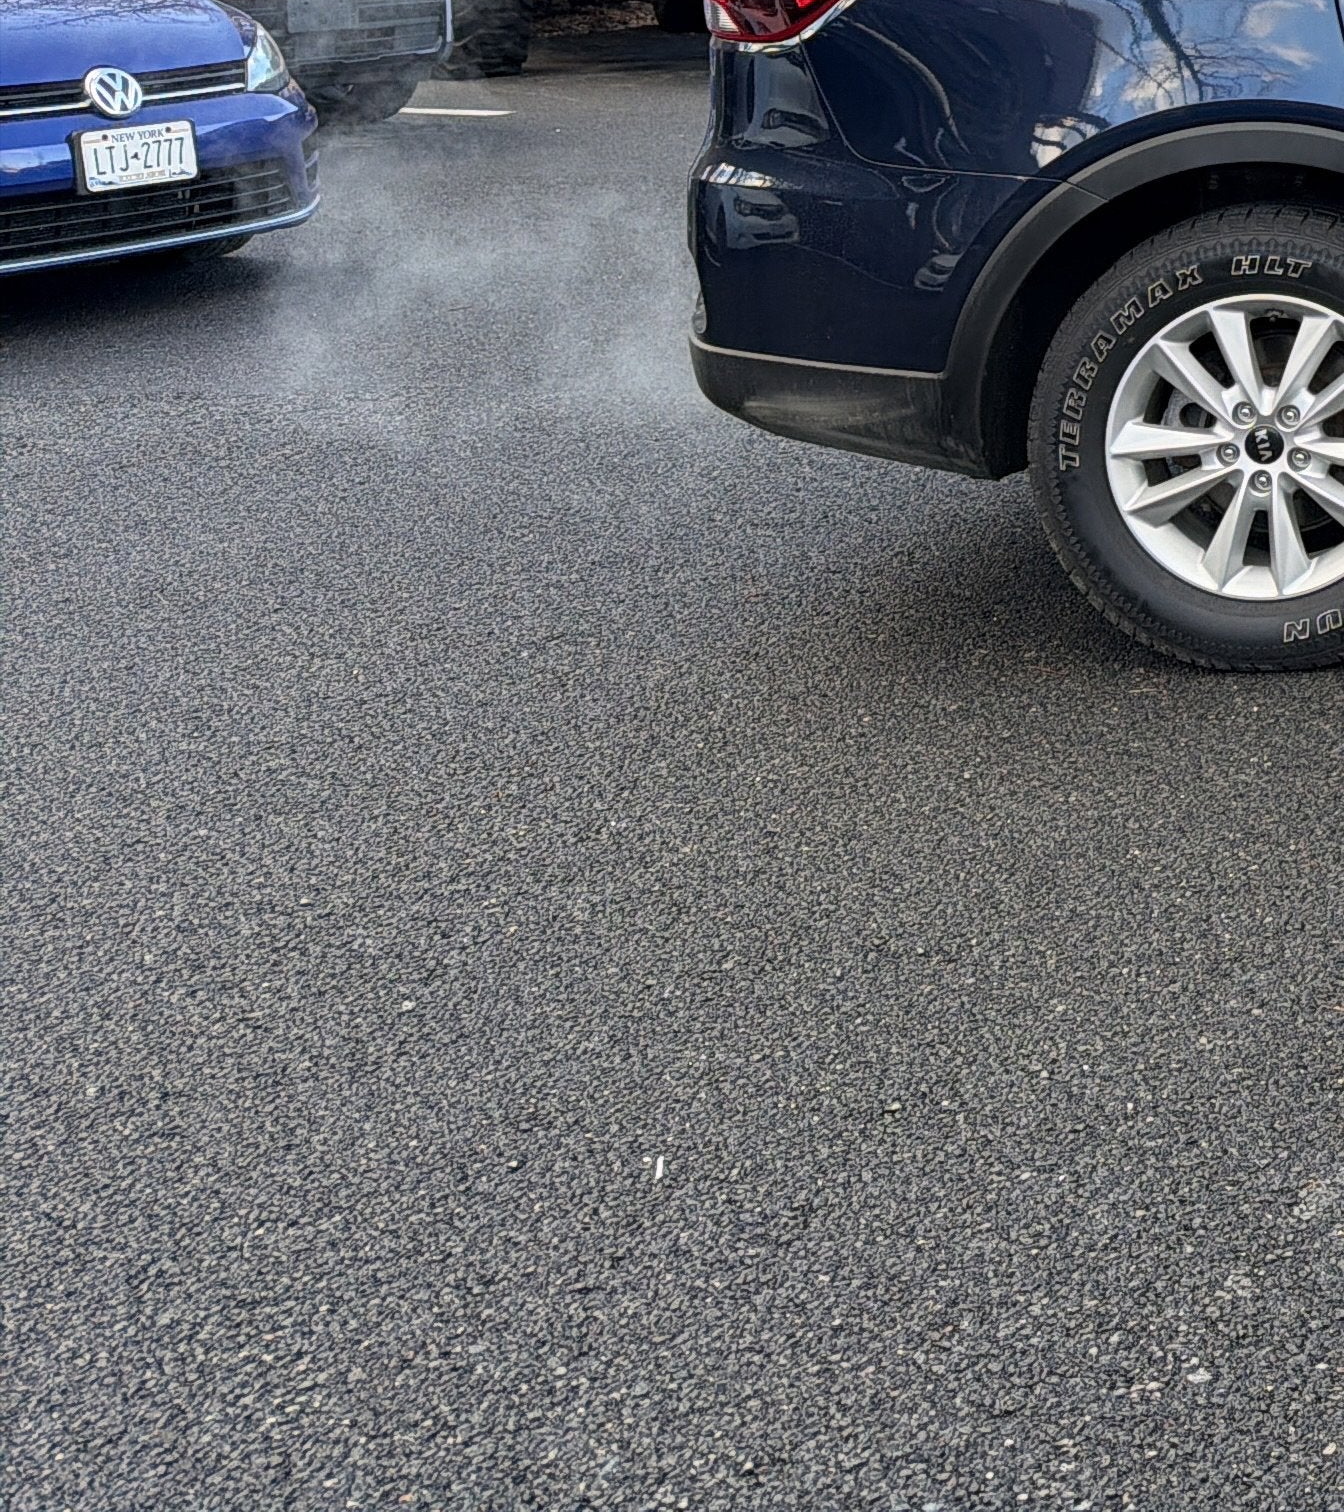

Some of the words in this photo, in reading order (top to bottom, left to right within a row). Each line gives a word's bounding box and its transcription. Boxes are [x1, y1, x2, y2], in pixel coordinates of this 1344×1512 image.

[112, 132, 135, 143] NEW
[139, 128, 164, 139] YORK
[1059, 265, 1203, 472] TERRAMAX
[1231, 255, 1312, 279] HLT
[1254, 429, 1273, 462] KIA
